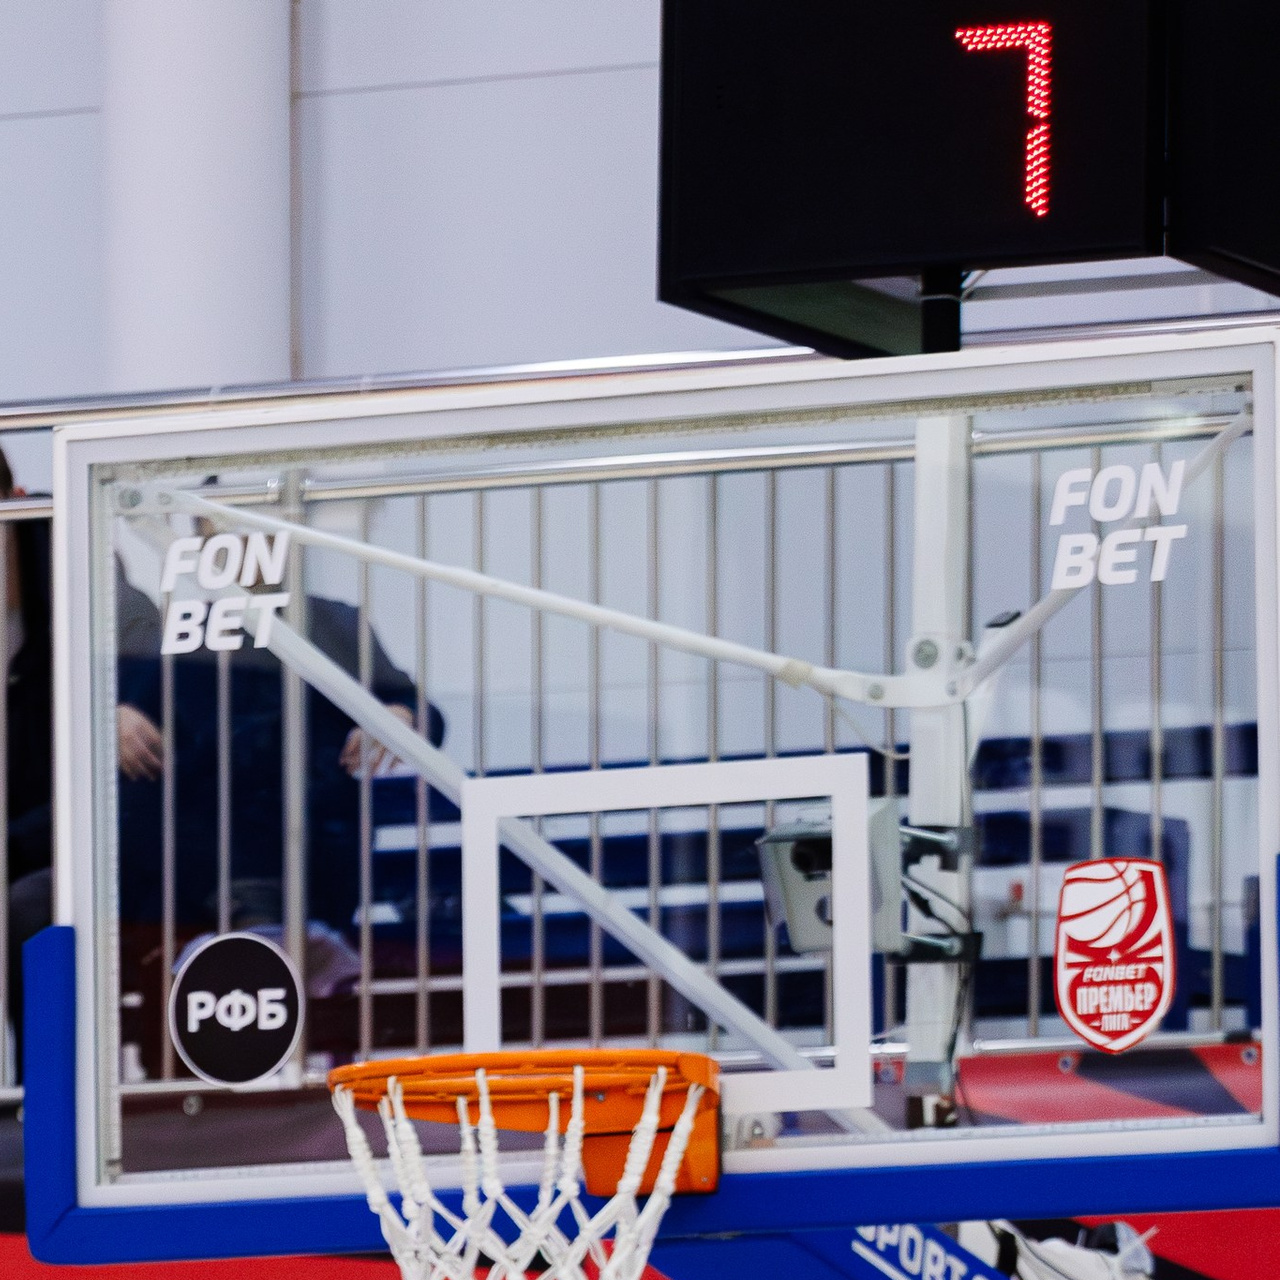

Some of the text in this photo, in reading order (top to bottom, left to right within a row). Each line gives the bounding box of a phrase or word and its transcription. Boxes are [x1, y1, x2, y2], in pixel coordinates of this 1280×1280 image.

[954, 22, 1052, 217] 7
[1049, 459, 1185, 526] FON
[160, 531, 290, 593] FON
[1051, 524, 1187, 590] BET
[160, 592, 291, 655] BET
[1076, 982, 1156, 1016] ПРЕМЬЕР
[1082, 963, 1146, 983] FONBET
[186, 987, 288, 1032] РФБ
